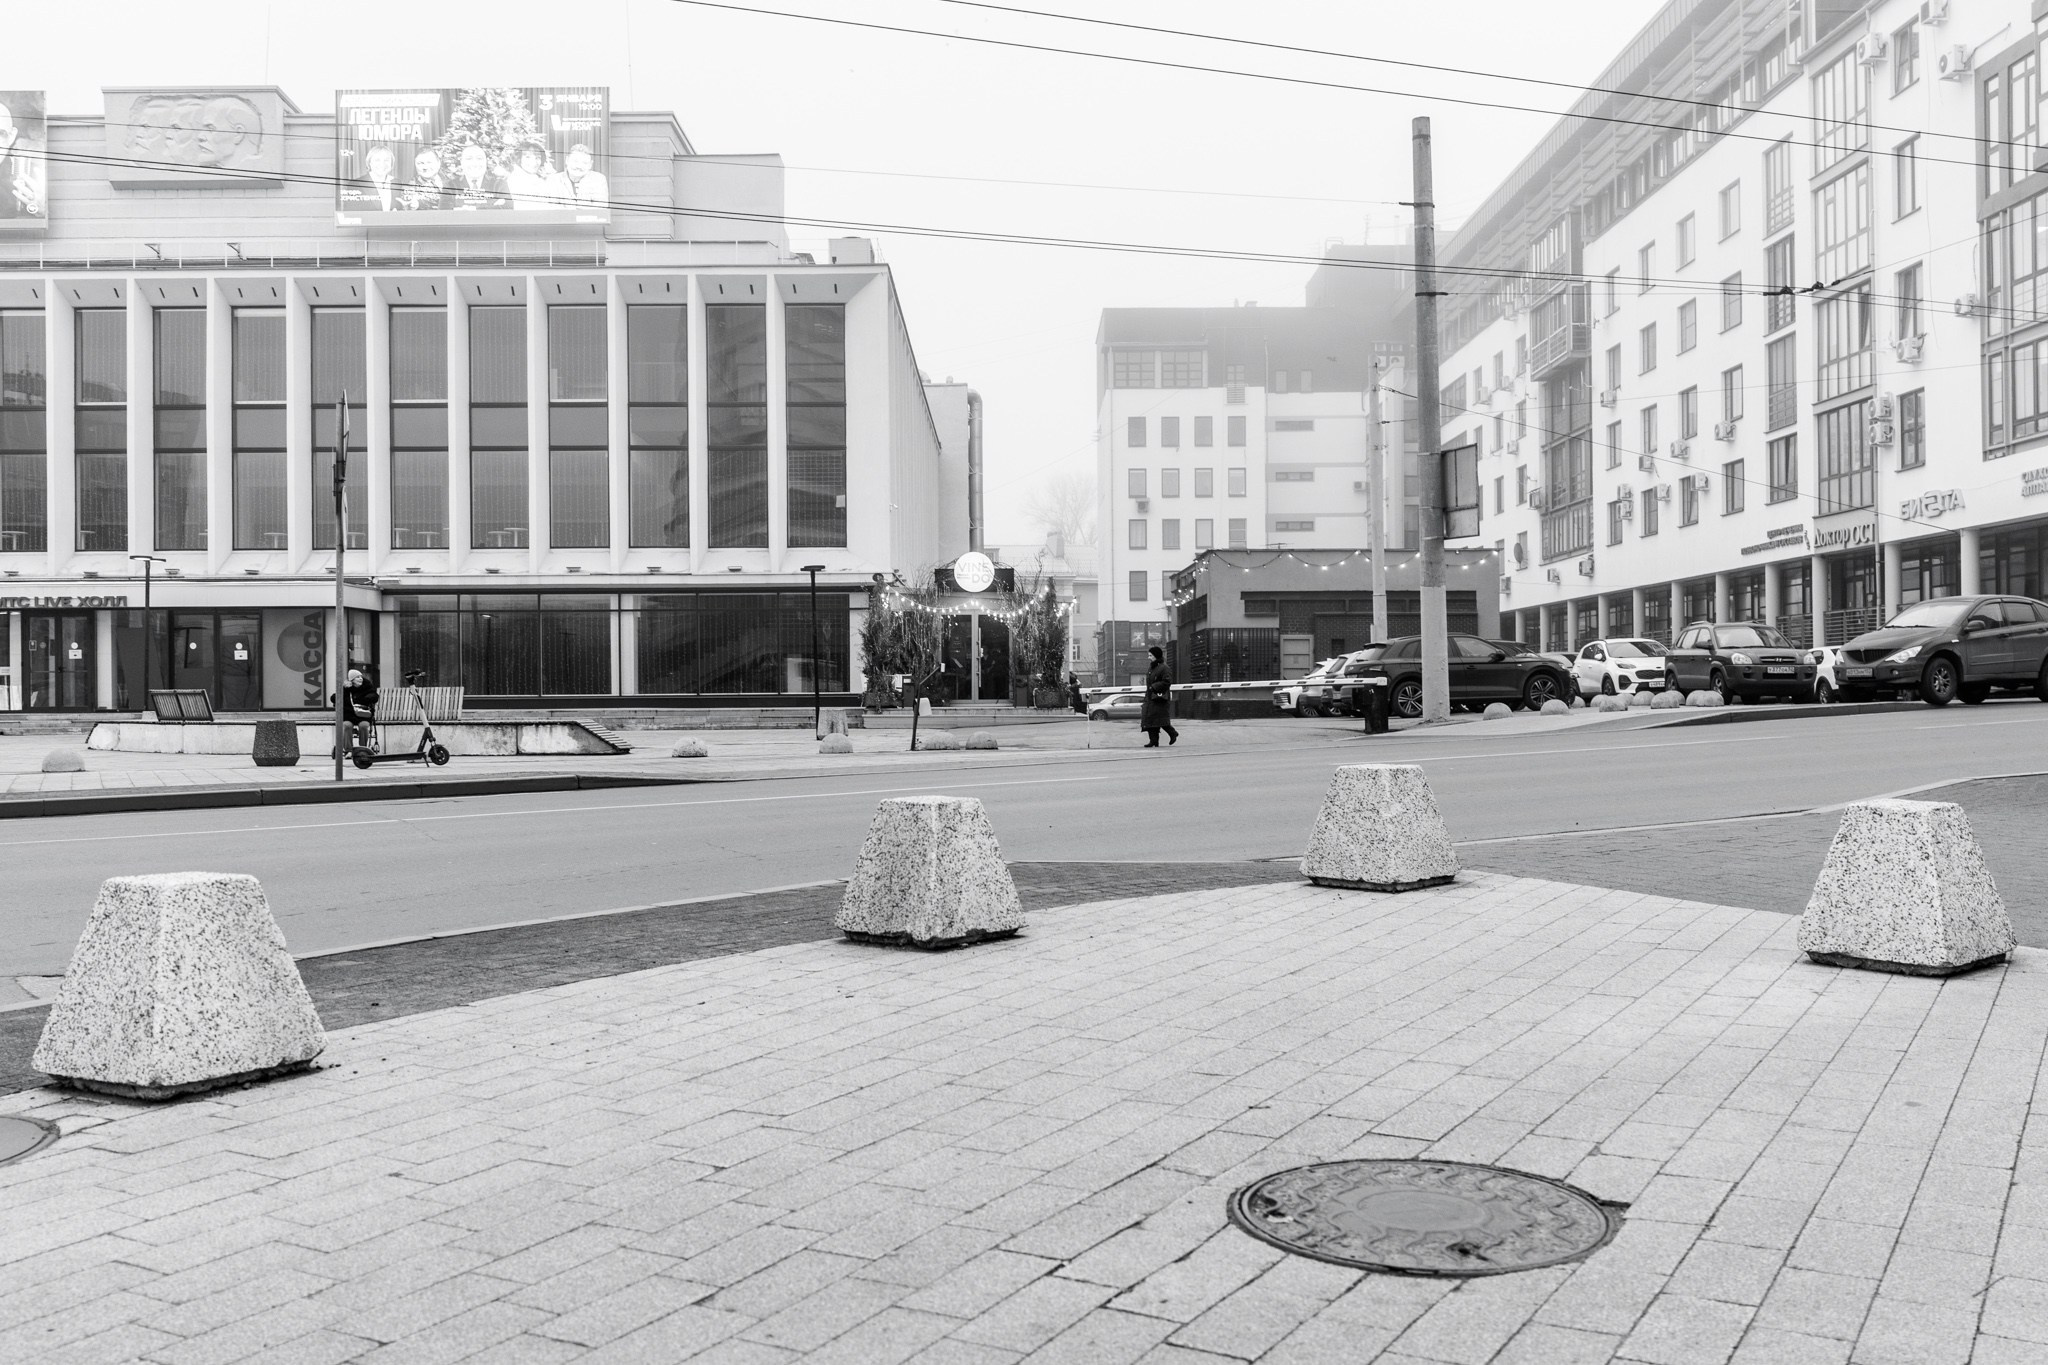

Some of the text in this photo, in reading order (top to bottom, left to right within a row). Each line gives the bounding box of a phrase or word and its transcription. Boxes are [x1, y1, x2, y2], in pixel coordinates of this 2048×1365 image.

[539, 94, 553, 110] 3
[556, 94, 602, 103] ЯНВАРЯ
[348, 107, 430, 124] ЛЕГЕНДЫ
[358, 124, 423, 141] ЮМОРА
[957, 562, 989, 573] VINE
[972, 574, 991, 584] DO
[34, 596, 73, 608] LIVE
[77, 596, 128, 608] ХОЛЛ
[303, 610, 322, 707] КАССА
